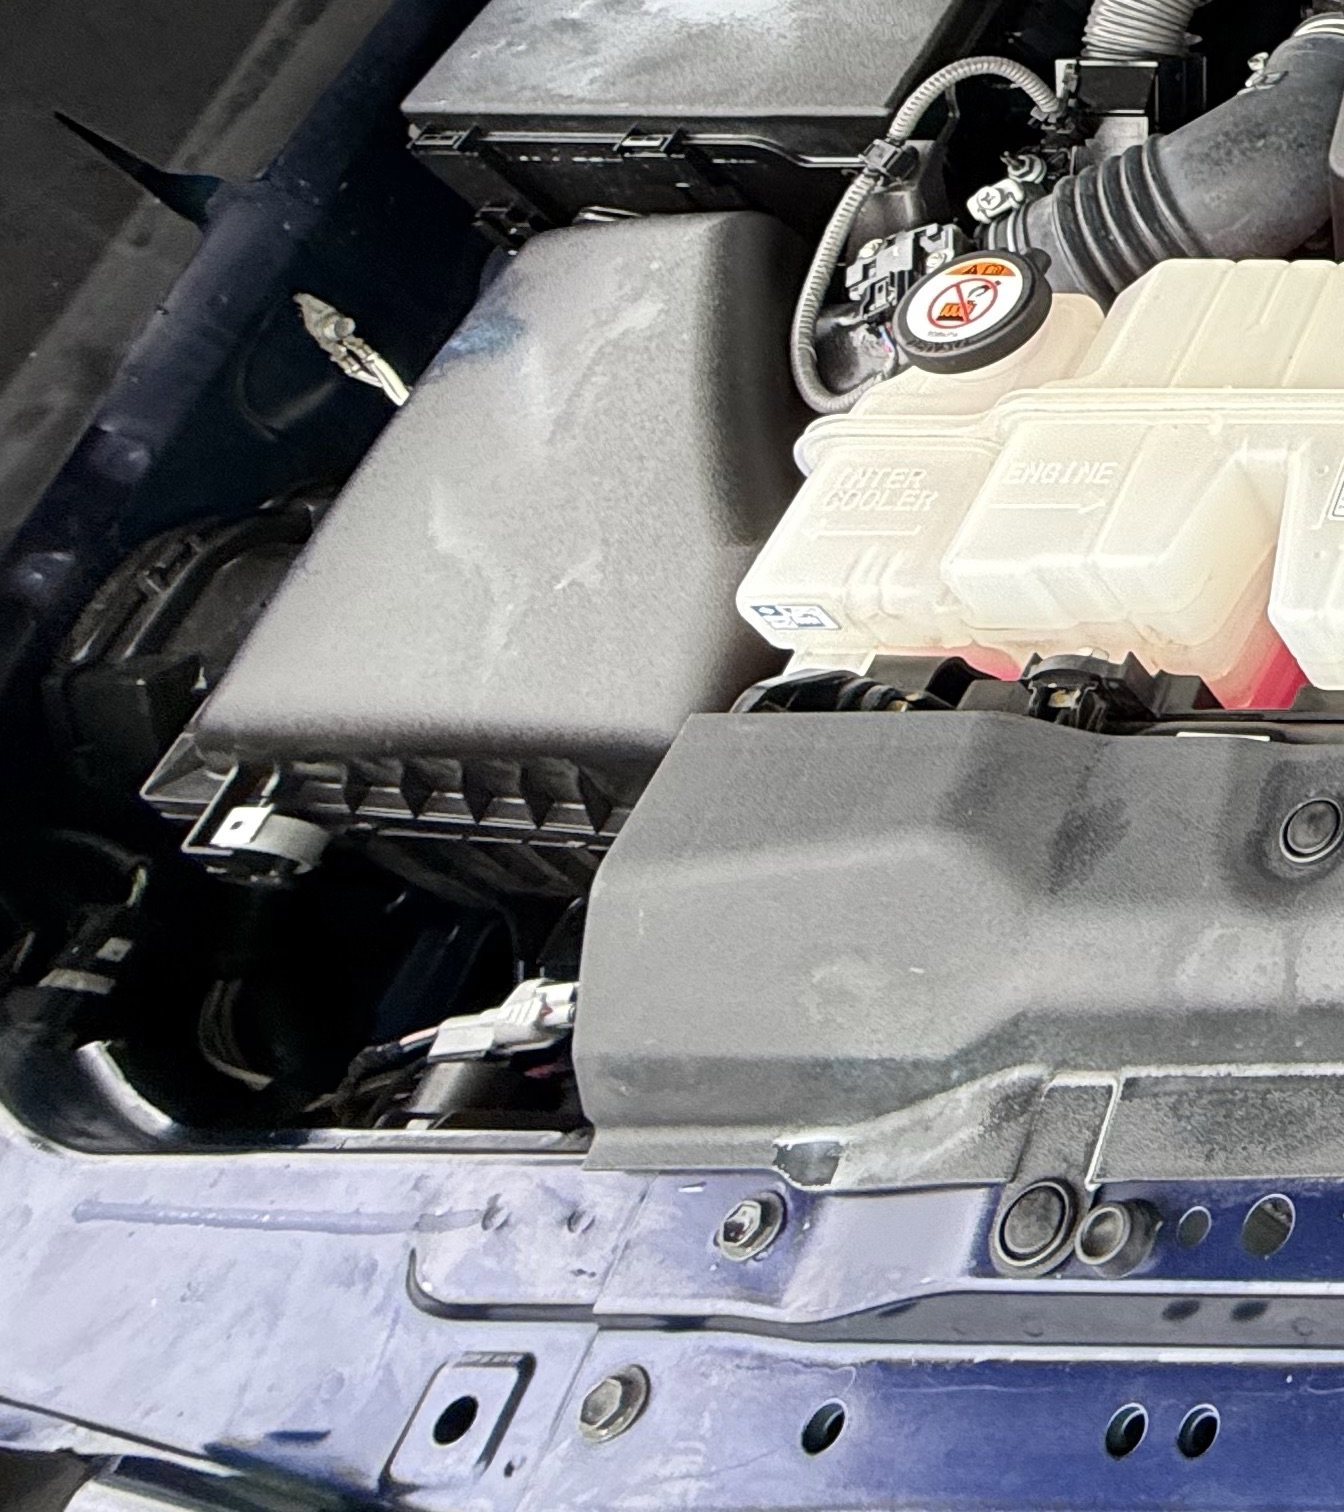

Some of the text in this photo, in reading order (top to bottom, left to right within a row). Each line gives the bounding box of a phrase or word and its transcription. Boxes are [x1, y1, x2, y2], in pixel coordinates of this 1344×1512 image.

[835, 467, 928, 488] INTER
[1005, 461, 1119, 485] ENGINE
[824, 489, 938, 512] COOLER
